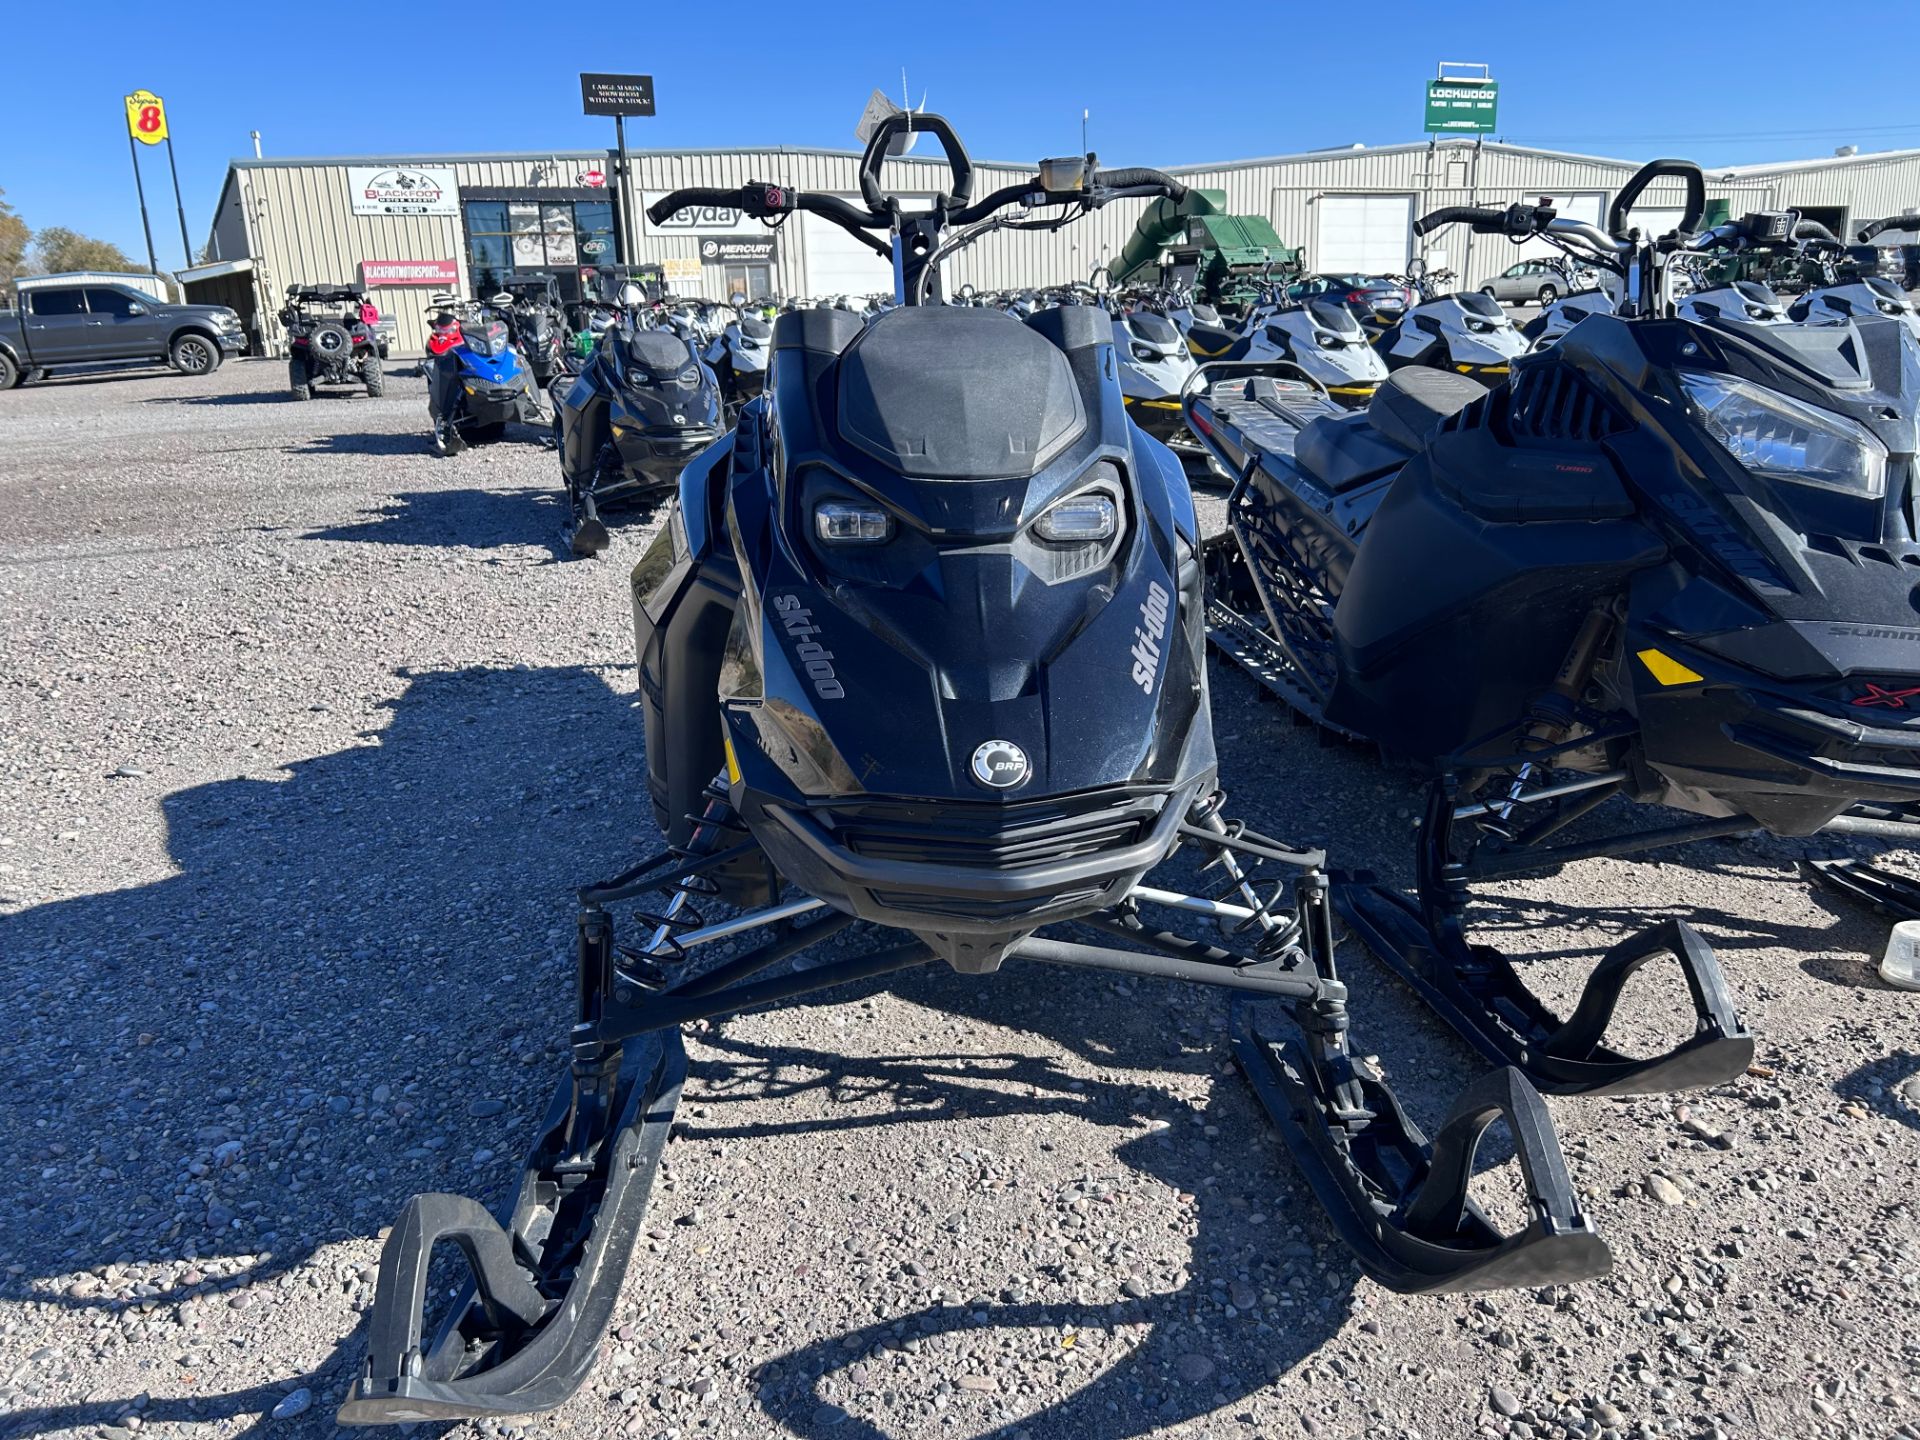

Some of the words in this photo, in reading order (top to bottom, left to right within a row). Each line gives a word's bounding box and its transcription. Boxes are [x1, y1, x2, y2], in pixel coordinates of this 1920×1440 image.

[617, 85, 643, 93] MARINE
[1429, 88, 1495, 100] LOCKWOOD
[138, 105, 161, 133] 8
[365, 189, 443, 200] BLACKFOOT
[668, 206, 742, 228] eyday
[719, 244, 773, 254] MERCURY
[1553, 464, 1592, 473] TURBO
[1131, 580, 1169, 695] ski-doo
[773, 594, 845, 699] ski-doo
[995, 762, 1024, 771] BRP
